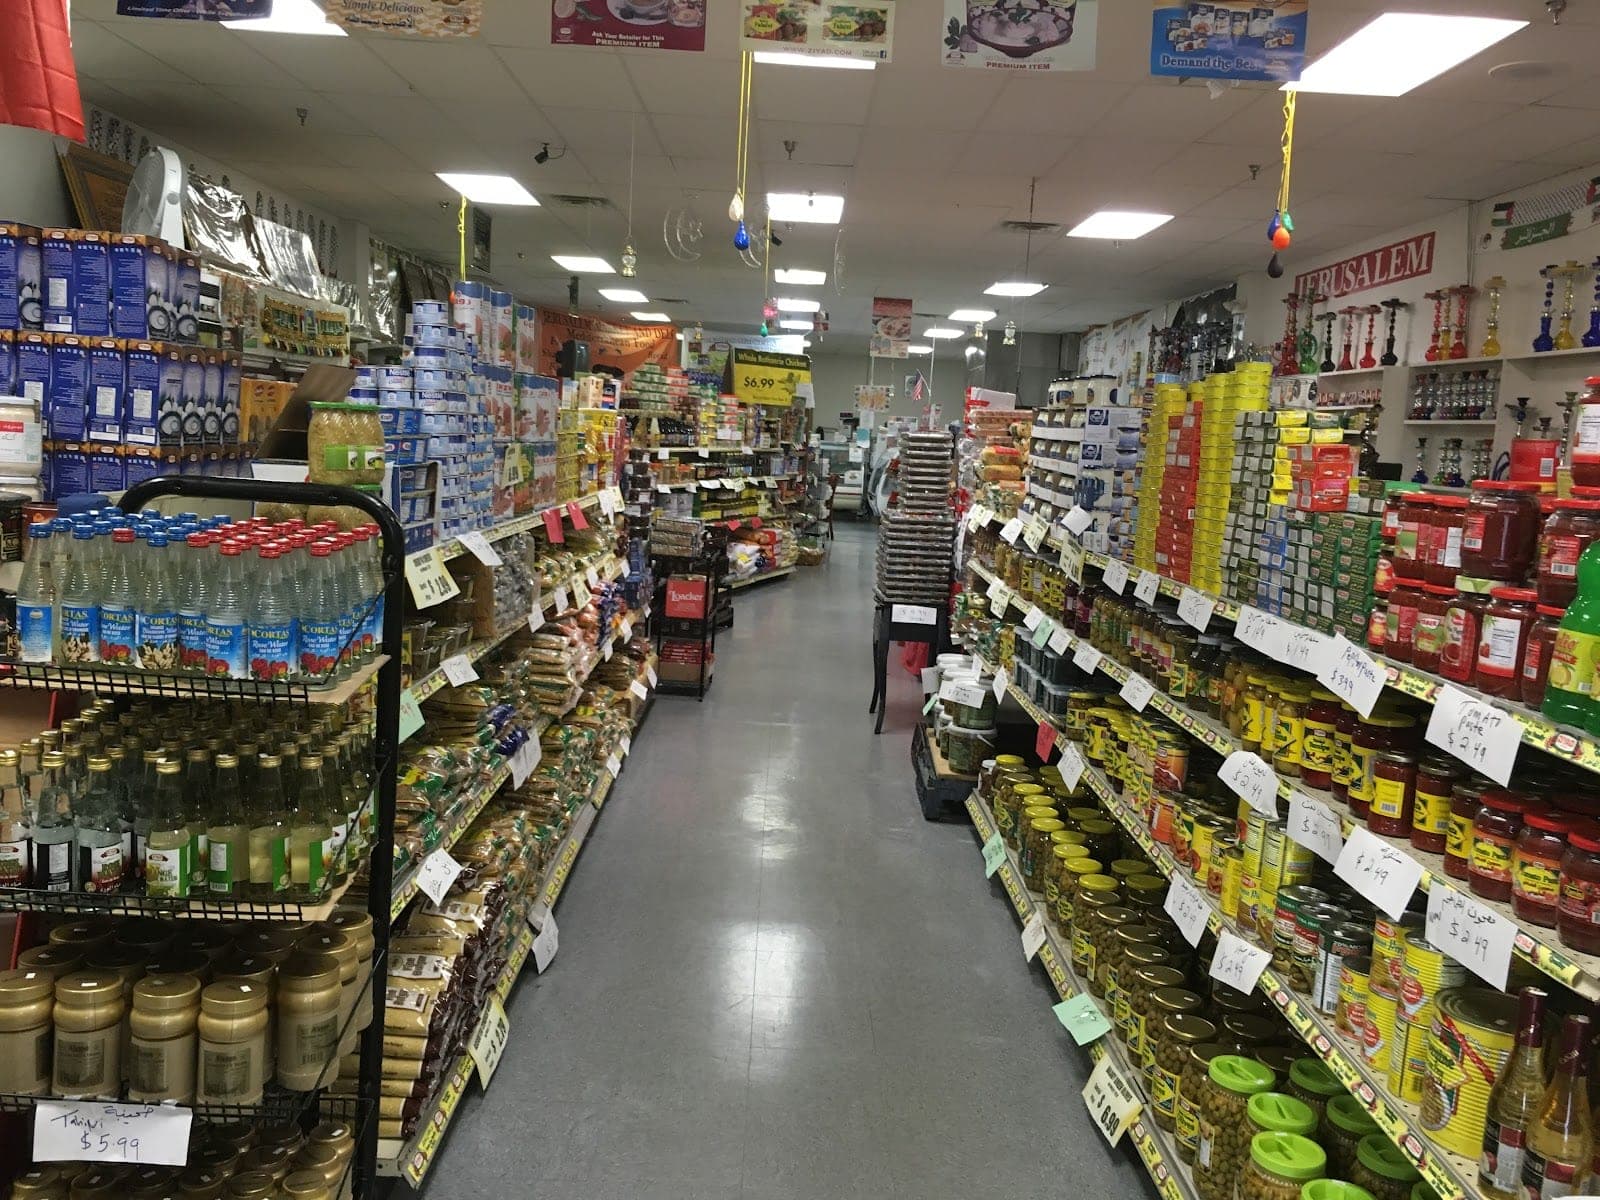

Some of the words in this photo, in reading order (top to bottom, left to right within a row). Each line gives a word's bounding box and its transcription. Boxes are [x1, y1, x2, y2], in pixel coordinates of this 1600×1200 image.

[341, 0, 375, 12] Simply
[379, 1, 424, 14] Delicious
[595, 38, 637, 47] PREMIUM
[639, 40, 660, 48] ITEM
[986, 61, 1027, 69] PREMIUM
[1162, 54, 1211, 69] Demand
[1213, 56, 1233, 71] the
[744, 377, 774, 388] $6.99
[669, 591, 703, 601] Loacker
